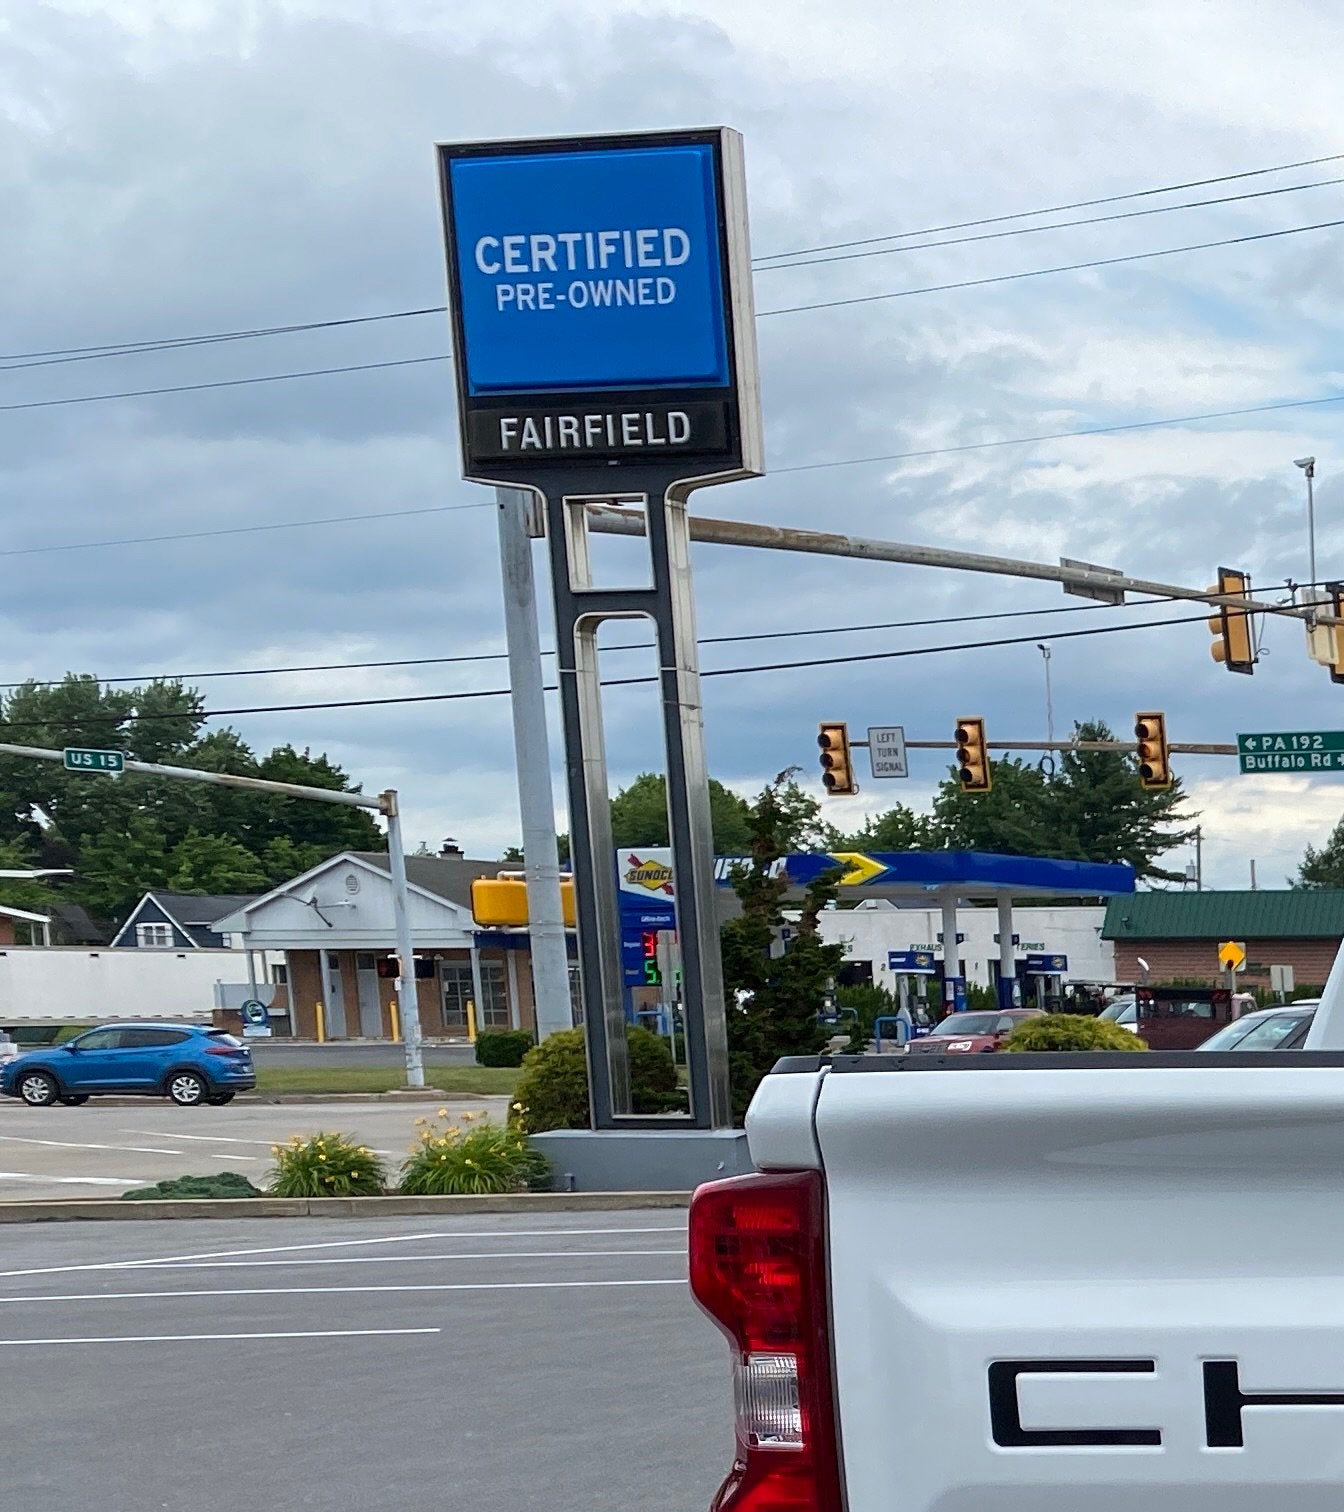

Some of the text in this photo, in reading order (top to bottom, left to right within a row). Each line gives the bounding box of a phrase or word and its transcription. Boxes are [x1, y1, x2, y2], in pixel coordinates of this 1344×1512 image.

[474, 228, 691, 274] CERTIFIED
[496, 277, 676, 311] PRE-OWNED
[499, 411, 691, 450] FAIRFIELD
[876, 732, 896, 743] LEFT
[1261, 735, 1324, 750] PA 192
[71, 752, 118, 767] US 15
[877, 747, 899, 757] TURN
[875, 761, 904, 772] SIGNAL
[1245, 753, 1331, 769] Buffalo Rd
[909, 943, 942, 952] EXHAUS
